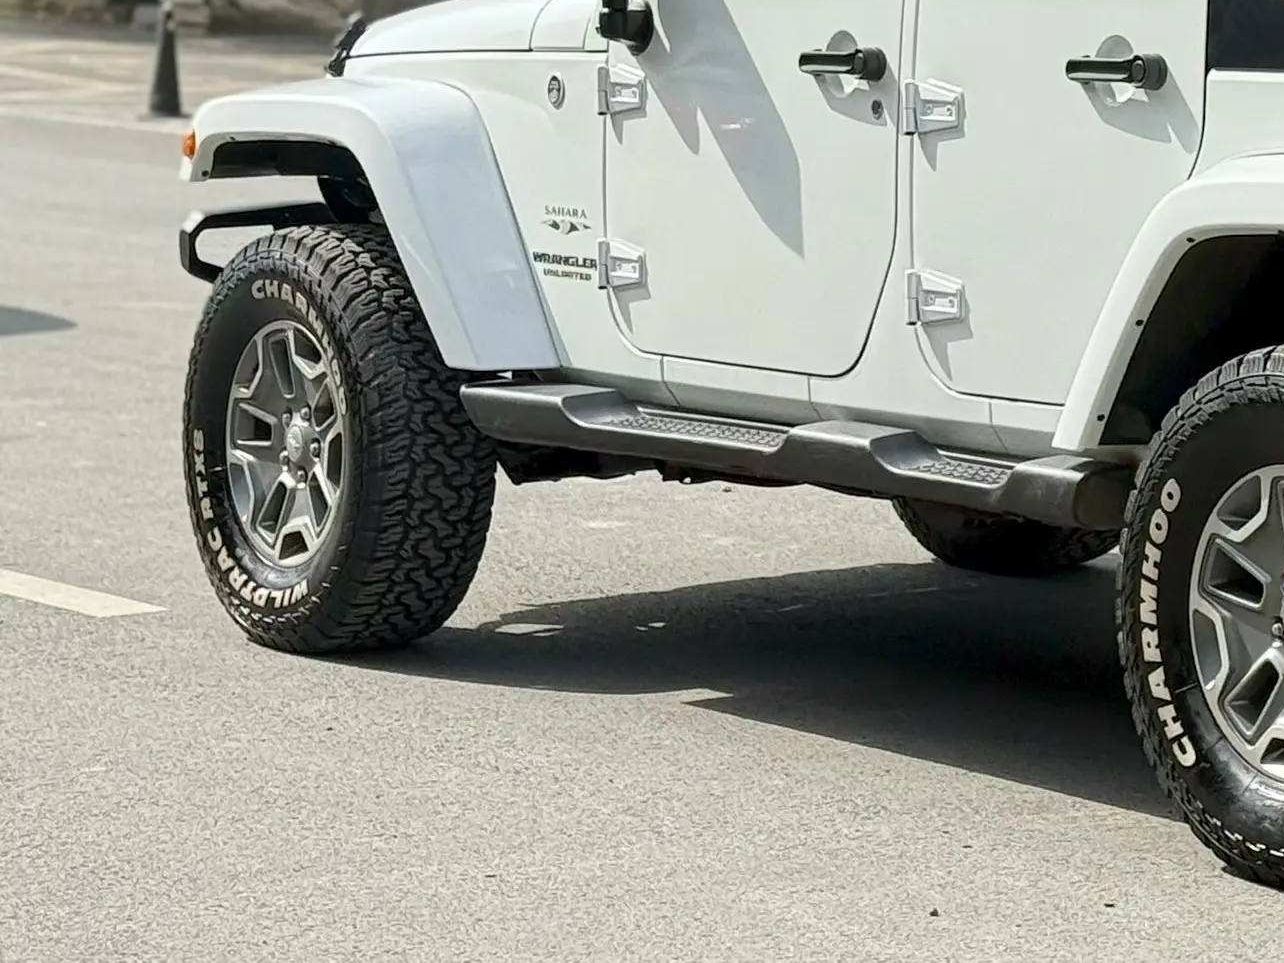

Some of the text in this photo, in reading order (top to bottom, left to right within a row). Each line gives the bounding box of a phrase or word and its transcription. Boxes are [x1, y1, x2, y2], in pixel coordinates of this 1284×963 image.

[544, 204, 588, 219] SAHARA
[532, 251, 598, 271] WRANGLER
[543, 268, 592, 281] UNLIMITED
[251, 278, 348, 417] CHARMHOO
[206, 525, 310, 610] WILDTRAC
[1139, 477, 1197, 768] CHARMHOO
